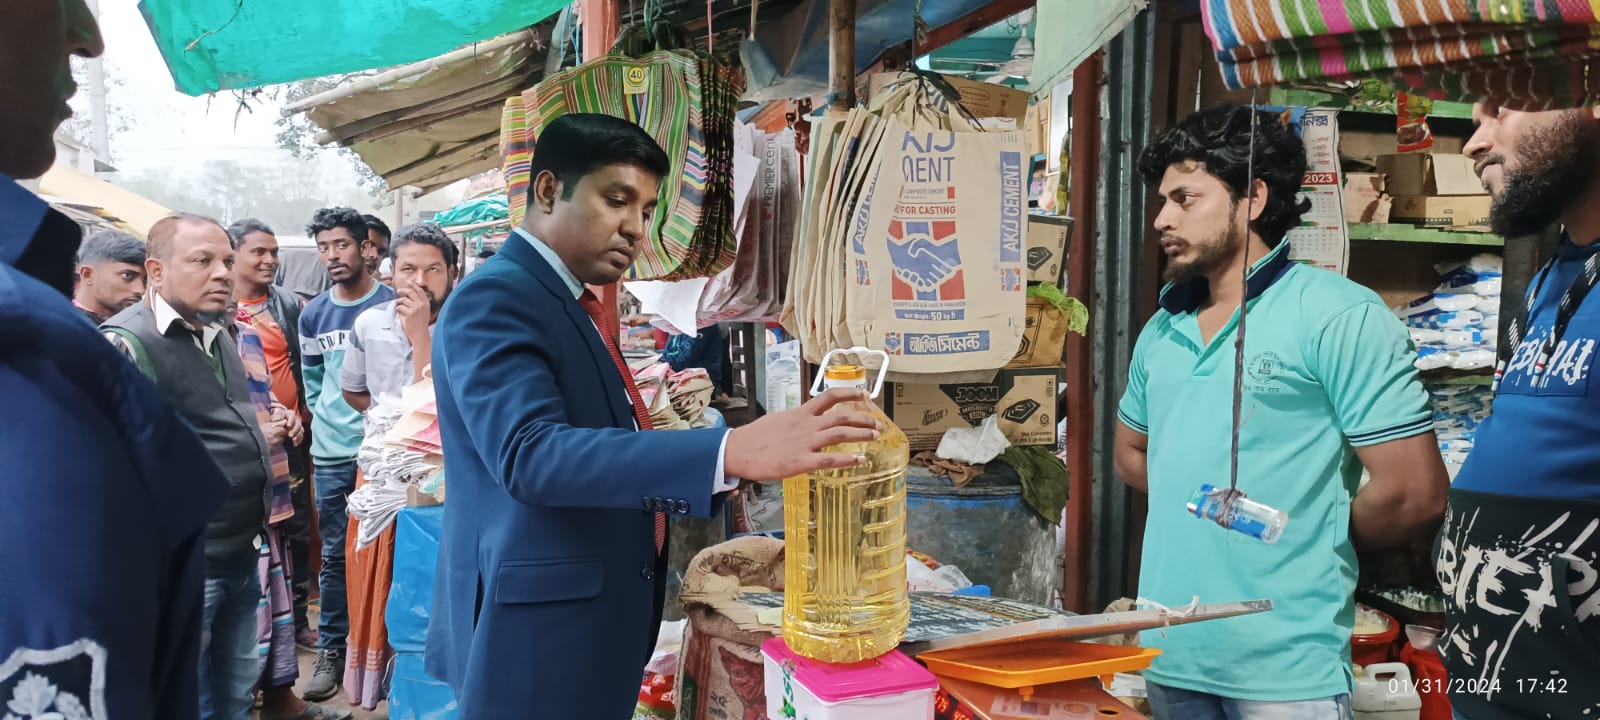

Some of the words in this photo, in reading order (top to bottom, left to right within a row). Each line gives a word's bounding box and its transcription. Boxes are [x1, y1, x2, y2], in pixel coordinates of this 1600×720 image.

[631, 70, 642, 79] 40
[1304, 174, 1333, 184] 2023
[1002, 162, 1019, 216] CEMENT
[900, 205, 917, 215] FOR
[919, 205, 956, 215] CASTING
[1003, 220, 1019, 252] AKIJ
[930, 311, 942, 320] 50
[956, 386, 999, 402] JOOM
